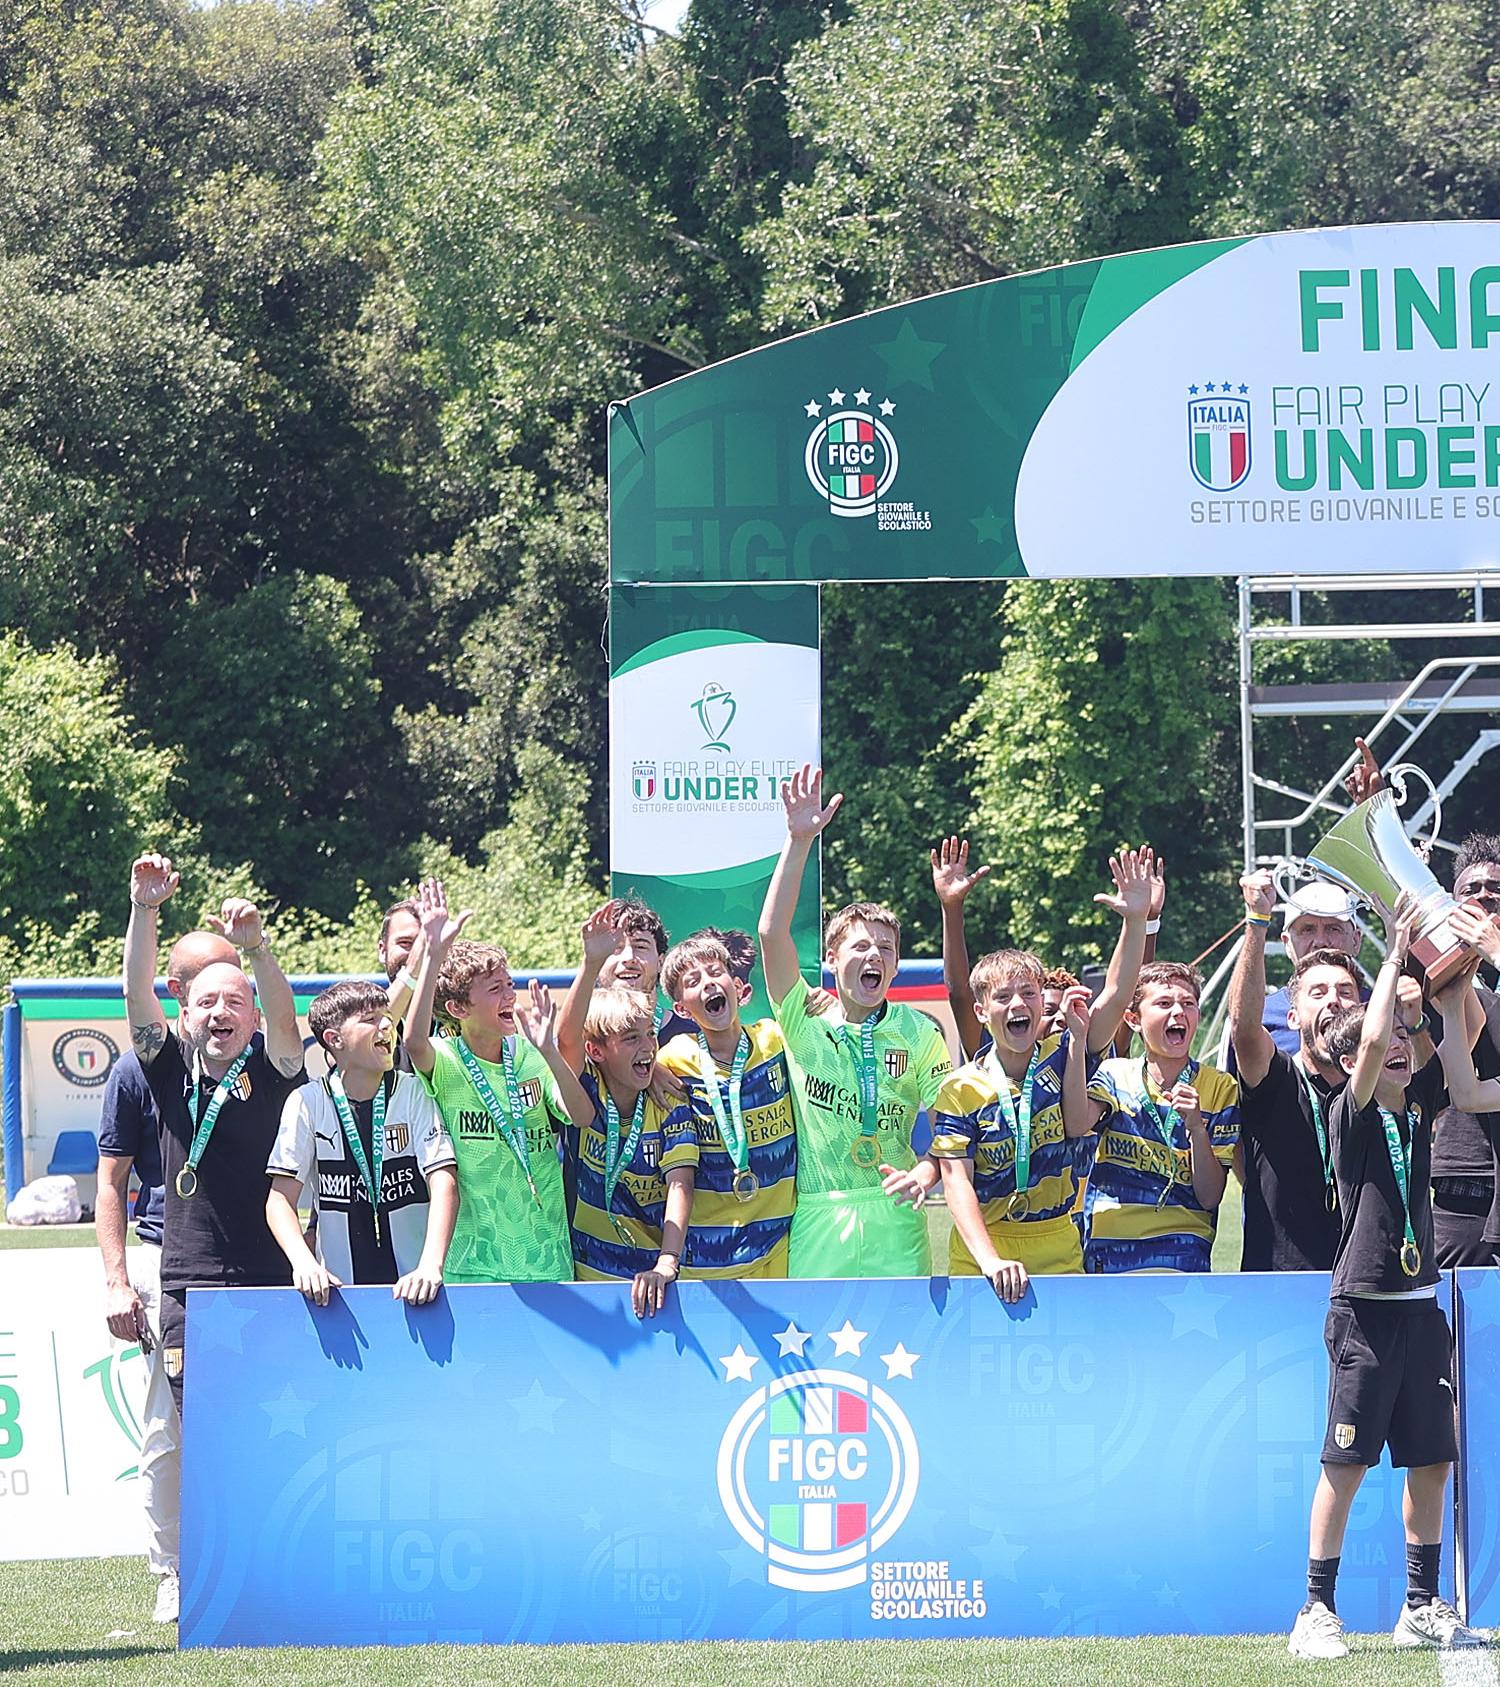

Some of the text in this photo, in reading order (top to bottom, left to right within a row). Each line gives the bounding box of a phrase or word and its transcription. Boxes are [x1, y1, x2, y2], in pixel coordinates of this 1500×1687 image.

[1193, 406, 1245, 423] ITALIA
[1273, 386, 1364, 426] FAIR
[1384, 383, 1490, 424] PLAY
[828, 444, 875, 466] FIGC
[843, 466, 862, 474] ITALIA
[878, 502, 914, 512] SETTORE
[878, 512, 930, 522] GIOVANILE E
[1190, 499, 1301, 524] SETTORE
[1310, 497, 1444, 522] GIOVANILE
[1454, 497, 1467, 519] E
[878, 521, 932, 531] SCOLASTICO
[664, 760, 796, 777] FAIR PLAY ELITE
[664, 777, 759, 800] UNDER
[632, 803, 675, 813] SETTORE
[677, 803, 727, 812] GIOVANILE
[738, 802, 784, 812] SCOLASTI
[224, 1058, 246, 1085] 2026
[466, 1058, 508, 1128] FINALE 2026
[837, 1087, 906, 1116] GA ALES
[508, 1090, 523, 1120] 2026
[373, 1124, 385, 1156] 2026
[624, 1125, 641, 1156] 2026
[751, 1118, 792, 1143] ERGIA
[1389, 1138, 1404, 1172] 2026
[381, 1168, 414, 1189] ALES
[768, 1438, 868, 1482] FIGC
[799, 1485, 837, 1499] ITALIA
[871, 1561, 949, 1581] SETTORE
[871, 1580, 983, 1600] GIOVANILE E
[871, 1599, 987, 1620] SCOLASTICO
